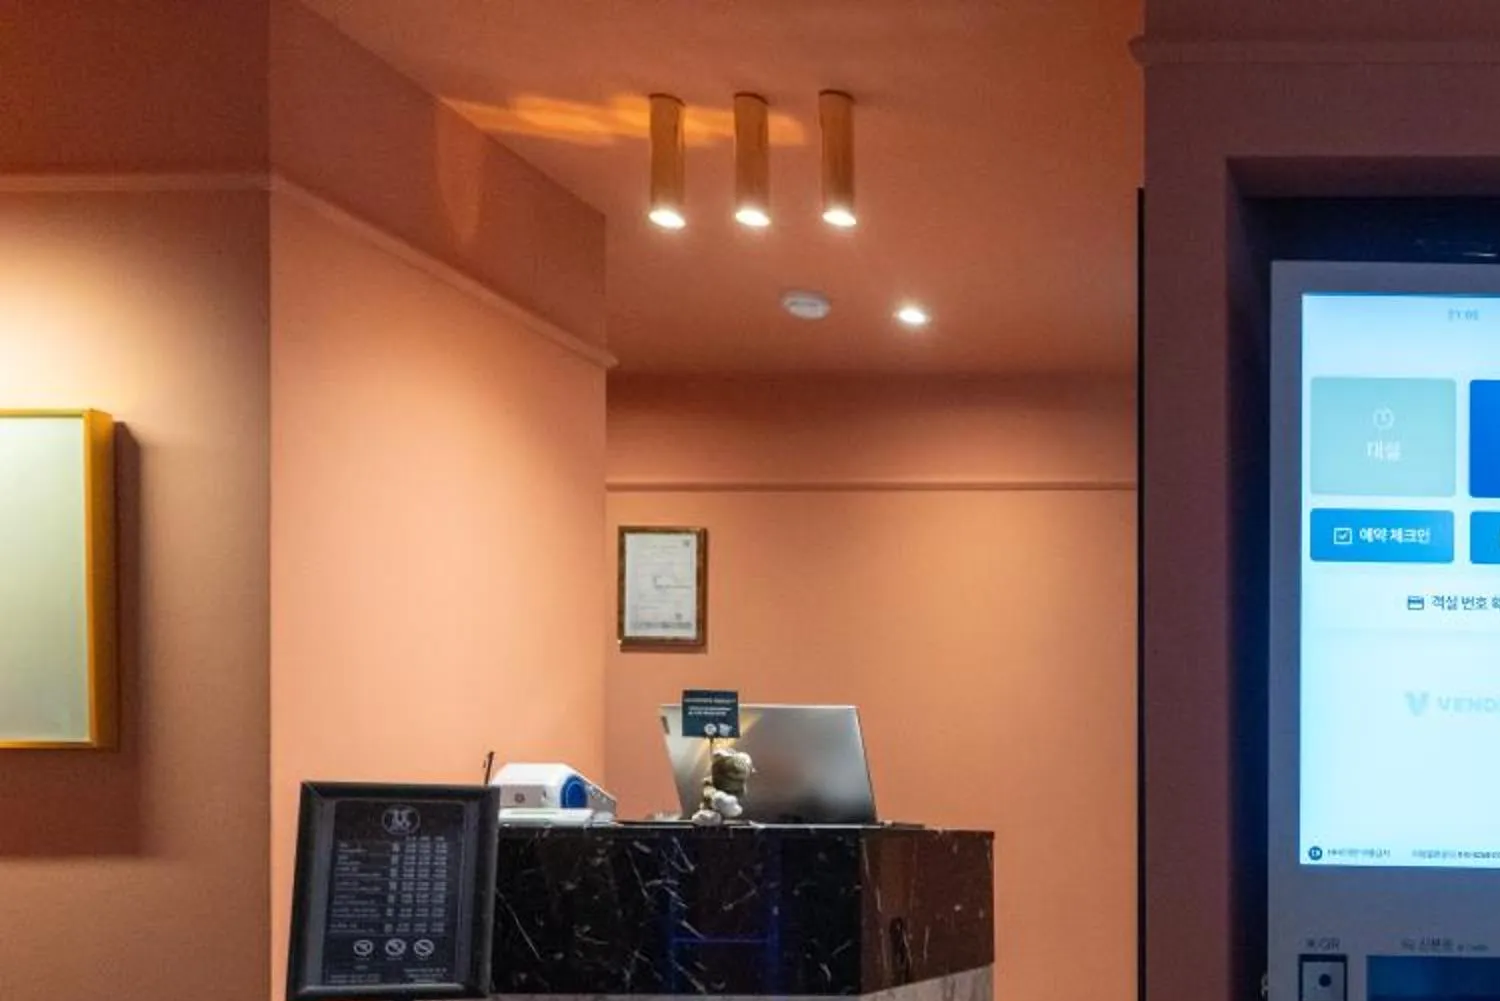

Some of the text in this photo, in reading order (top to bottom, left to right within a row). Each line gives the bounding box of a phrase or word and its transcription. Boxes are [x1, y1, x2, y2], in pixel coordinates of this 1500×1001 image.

[1359, 527, 1431, 545] 예약 체크인
[1431, 595, 1458, 612] 객실
[1461, 595, 1489, 612] 번호
